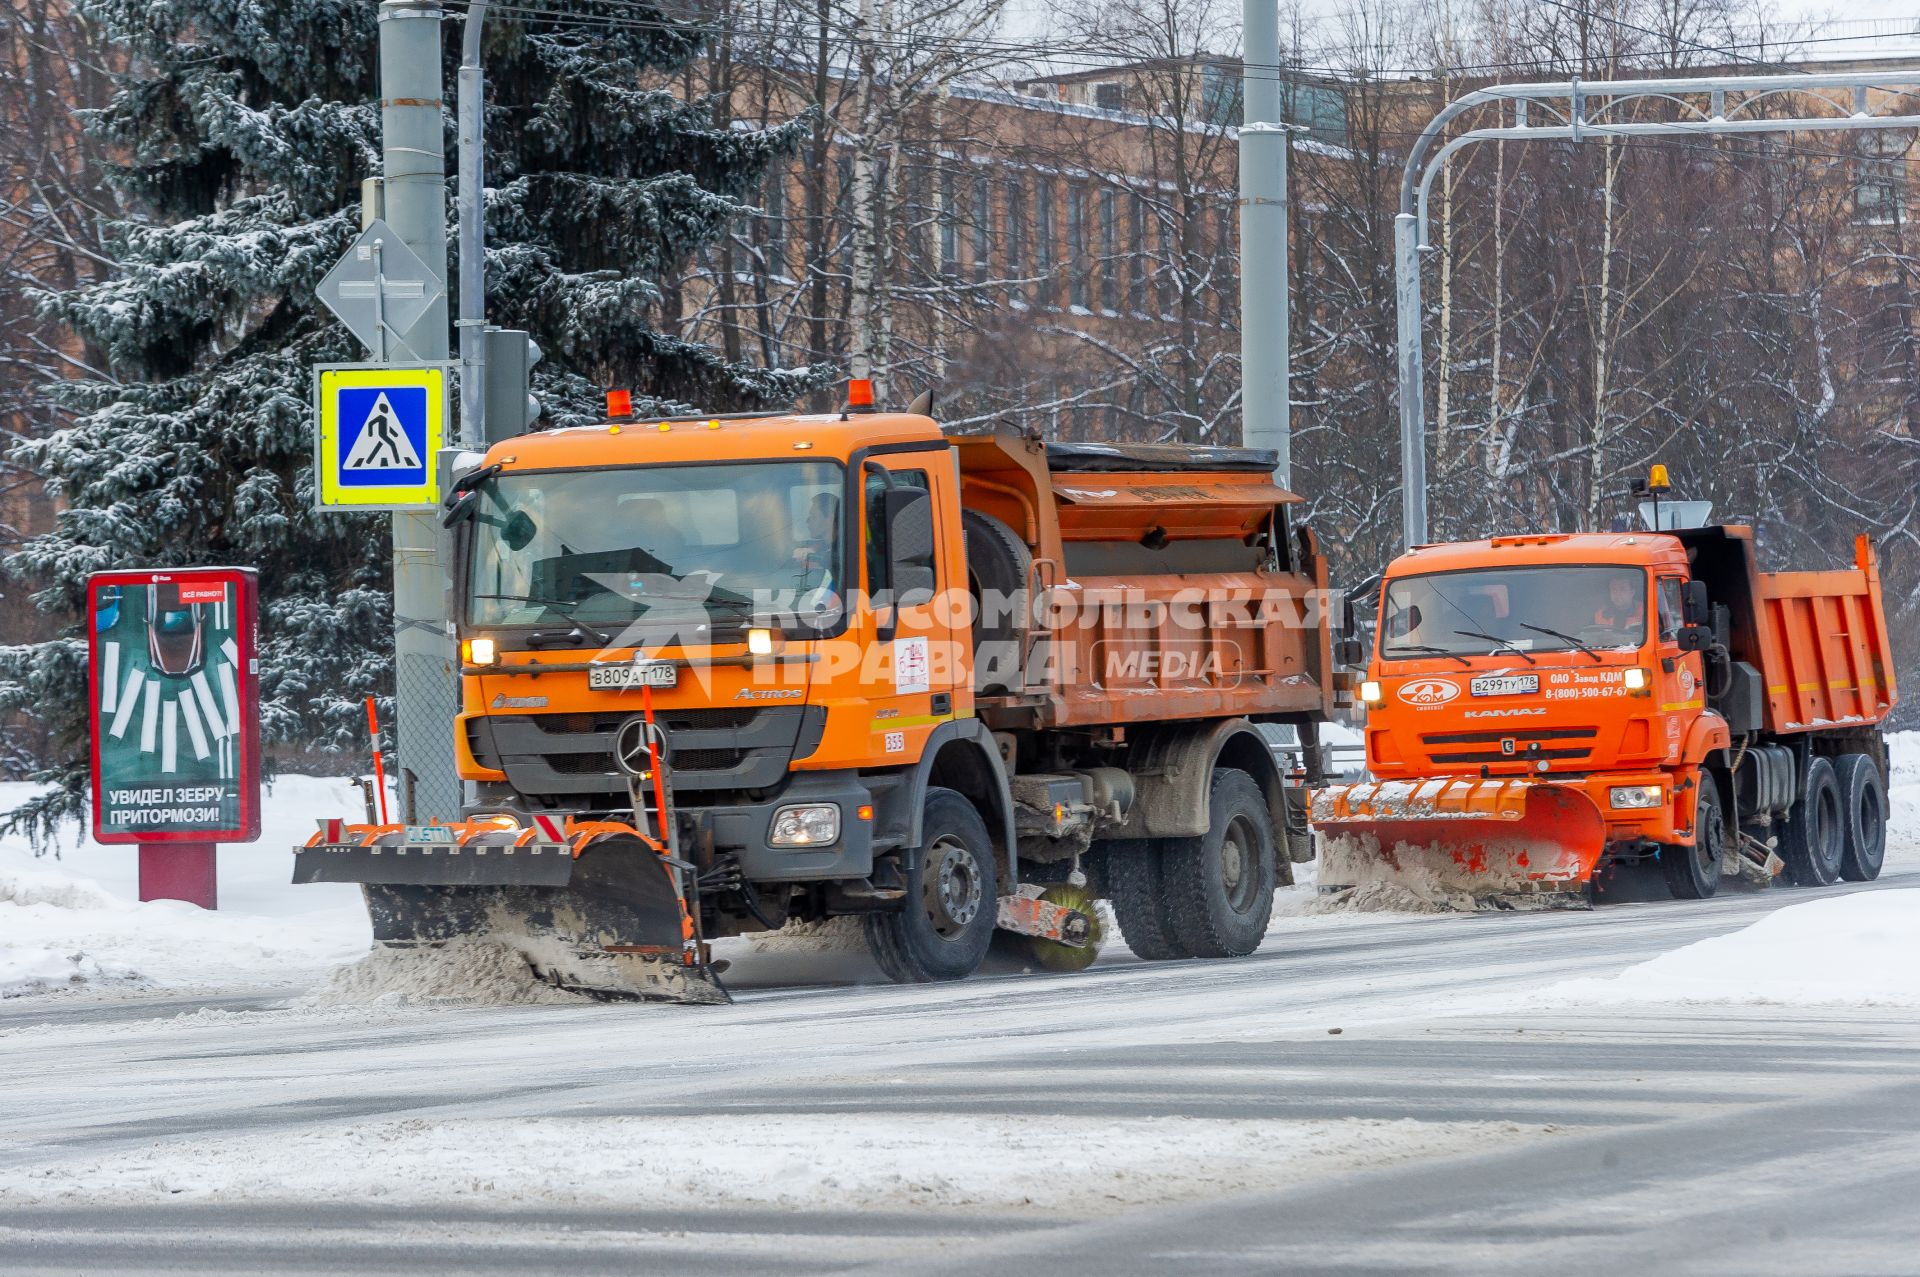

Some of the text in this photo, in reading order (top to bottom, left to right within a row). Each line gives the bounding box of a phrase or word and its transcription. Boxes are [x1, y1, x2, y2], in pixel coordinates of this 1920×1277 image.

[594, 667, 672, 685] В809АТ 178
[1475, 676, 1536, 692] В299ТУ 178
[1550, 673, 1570, 684] ОАО
[1545, 687, 1628, 699] 8-(800)-500-67-67
[109, 789, 173, 806] УВИДЕЛ
[175, 787, 225, 803] ЗЕБРУ
[110, 807, 220, 825] ПРИТОРМОЗИ!
